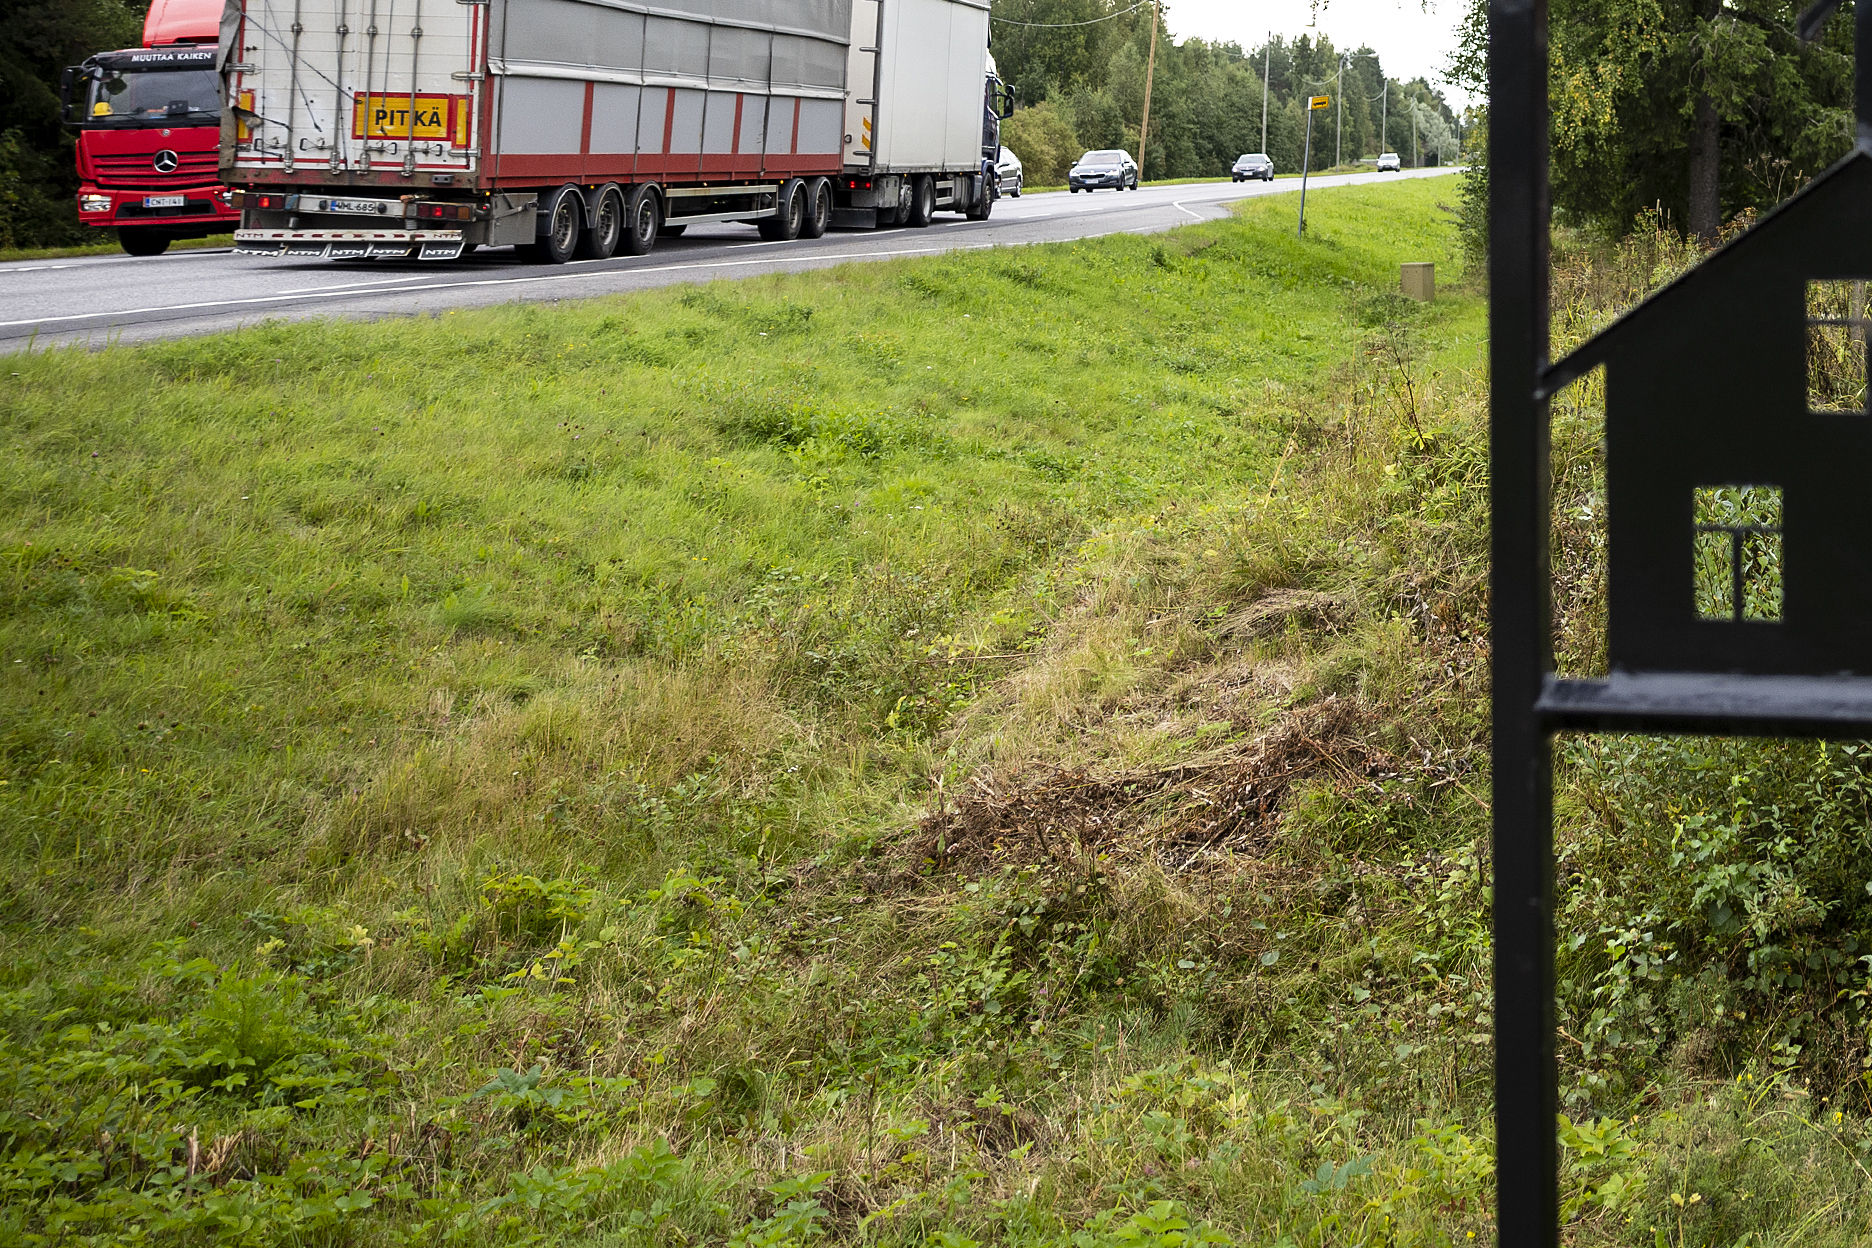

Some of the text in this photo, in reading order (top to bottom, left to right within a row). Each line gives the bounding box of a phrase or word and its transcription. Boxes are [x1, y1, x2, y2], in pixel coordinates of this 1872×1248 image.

[131, 52, 212, 62] MUUTTAA KAIKEN
[375, 106, 442, 127] PITKÄ
[232, 248, 279, 257] NTM
